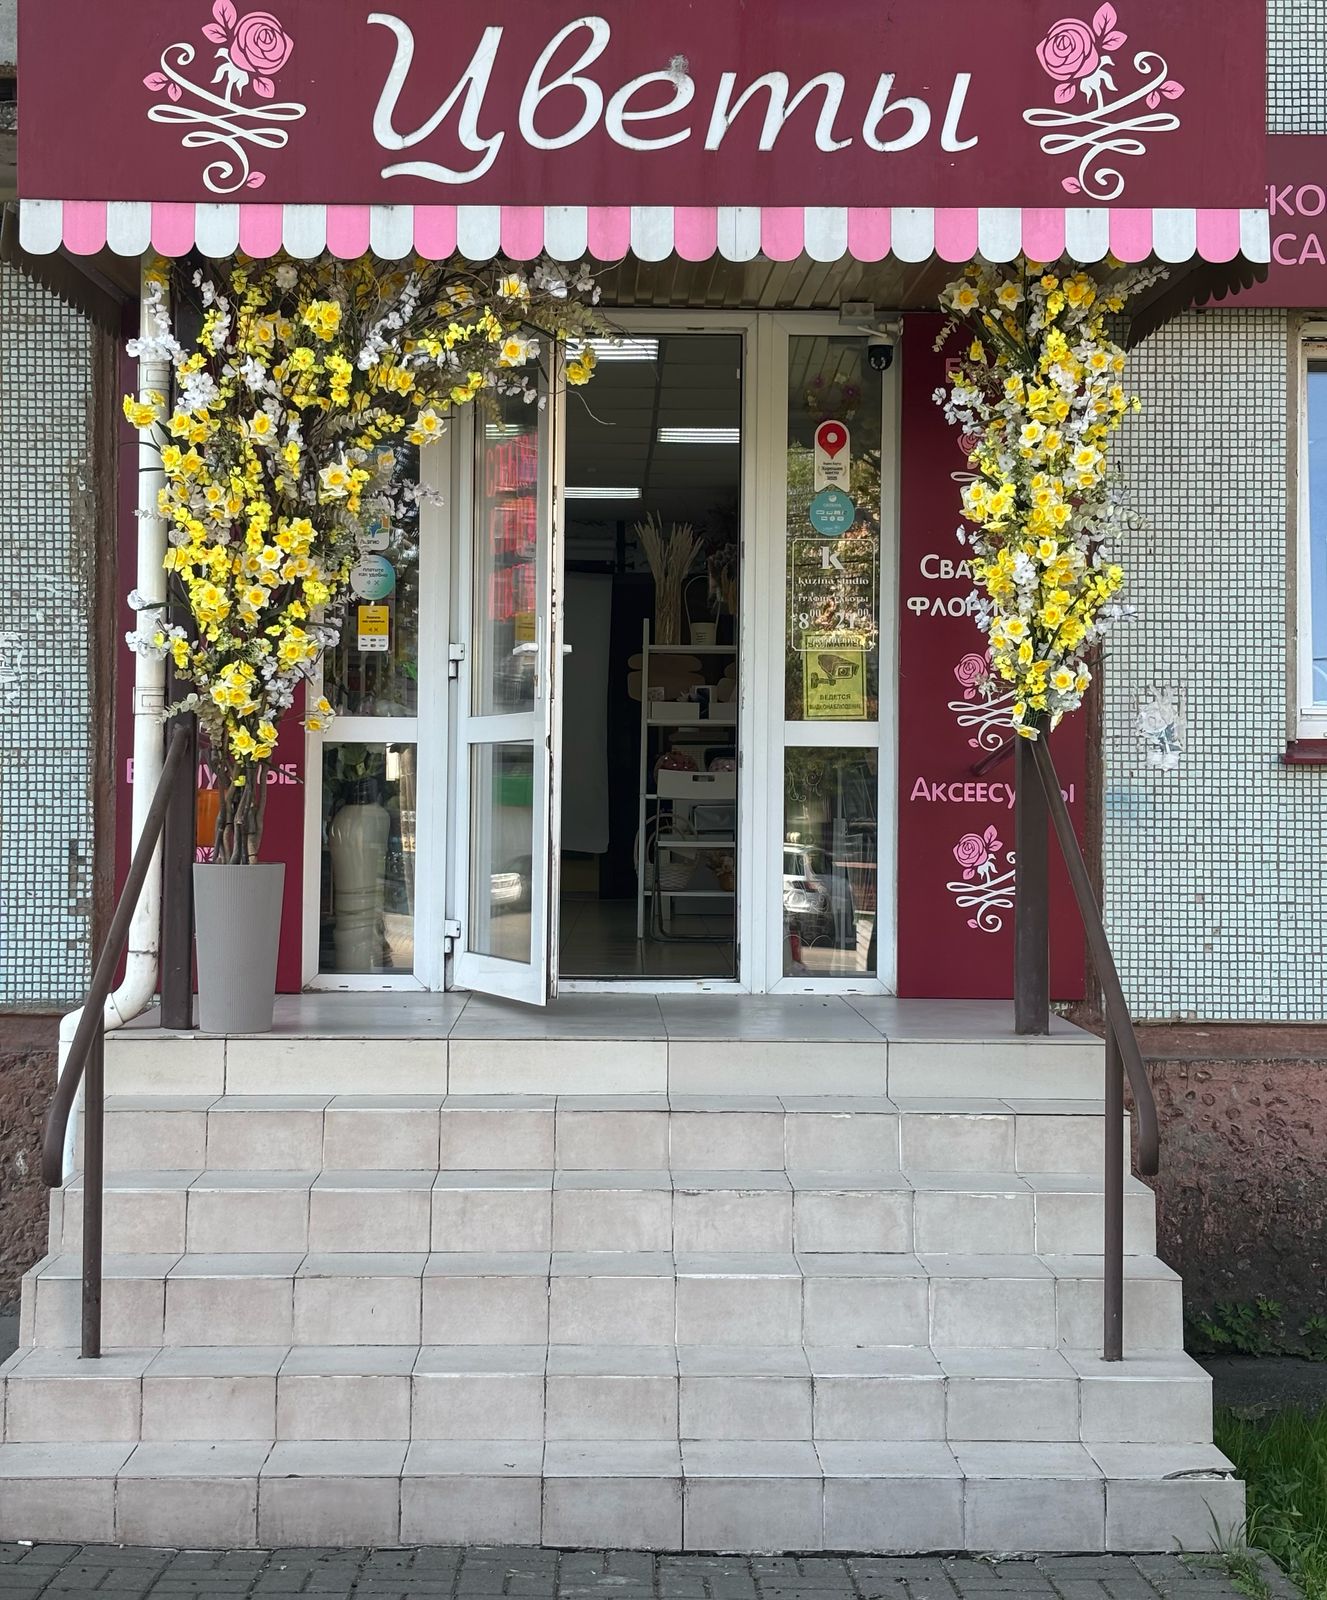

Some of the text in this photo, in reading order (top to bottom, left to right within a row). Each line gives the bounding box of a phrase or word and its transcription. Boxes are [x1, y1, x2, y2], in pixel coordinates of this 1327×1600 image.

[366, 12, 979, 185] Цветы
[1265, 184, 1327, 217] КО
[837, 577, 869, 585] studio
